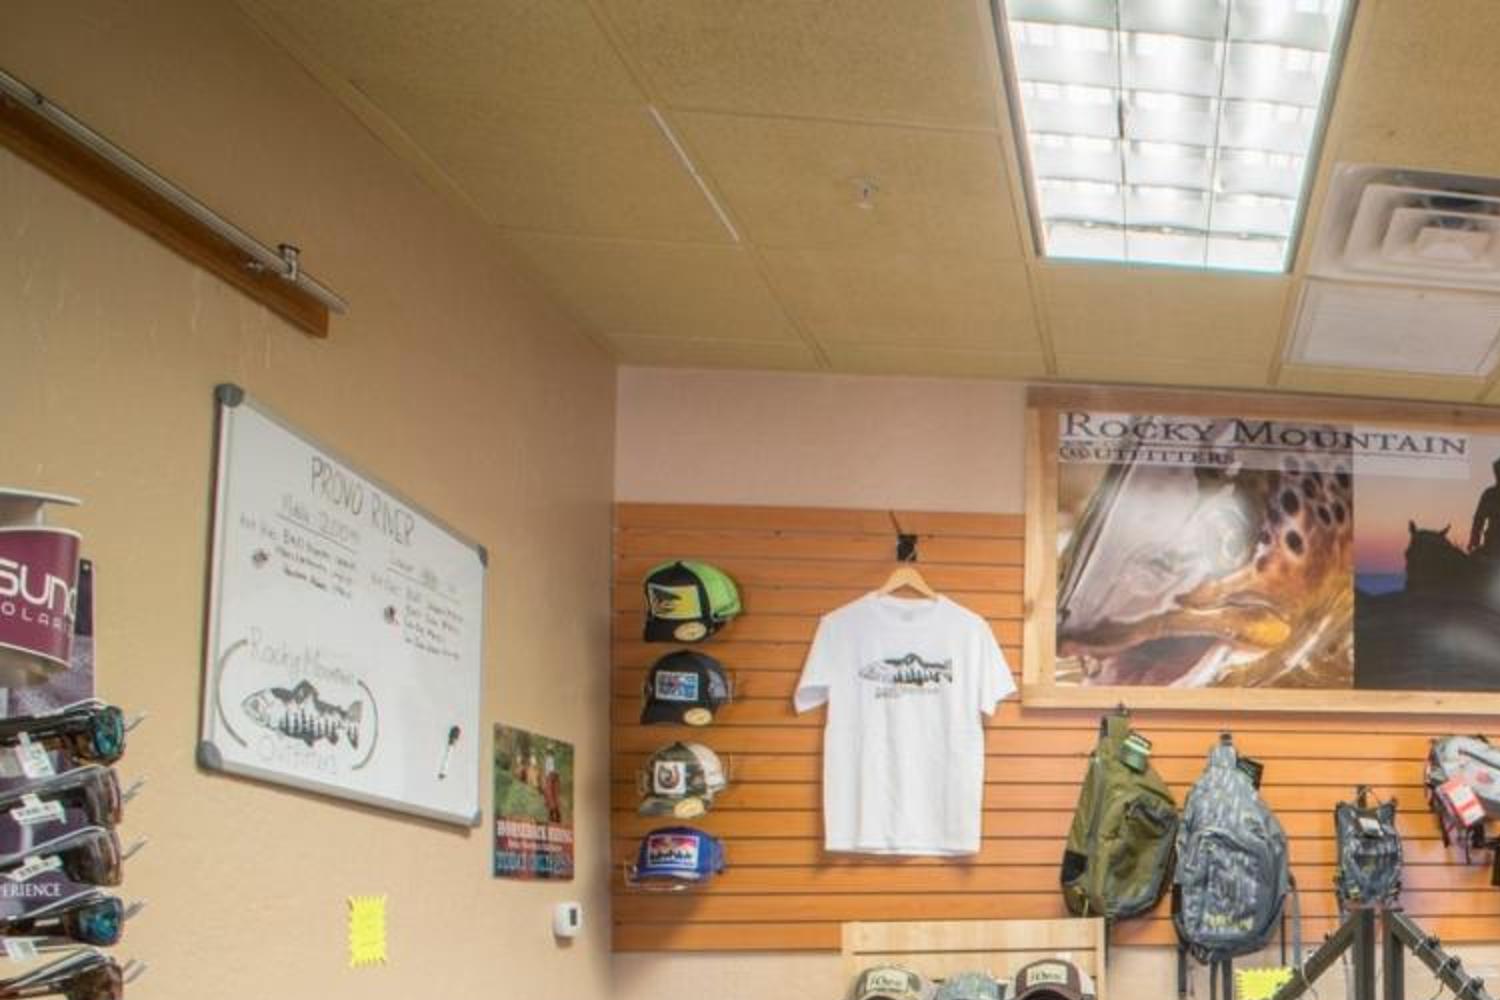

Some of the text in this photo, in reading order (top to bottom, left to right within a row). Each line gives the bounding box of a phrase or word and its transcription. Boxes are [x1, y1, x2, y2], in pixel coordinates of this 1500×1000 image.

[1065, 411, 1466, 455] ROCKY MOUNTAIN
[310, 455, 364, 516] PROVO
[370, 491, 415, 545] RIVER
[0, 882, 62, 898] ERIENCE
